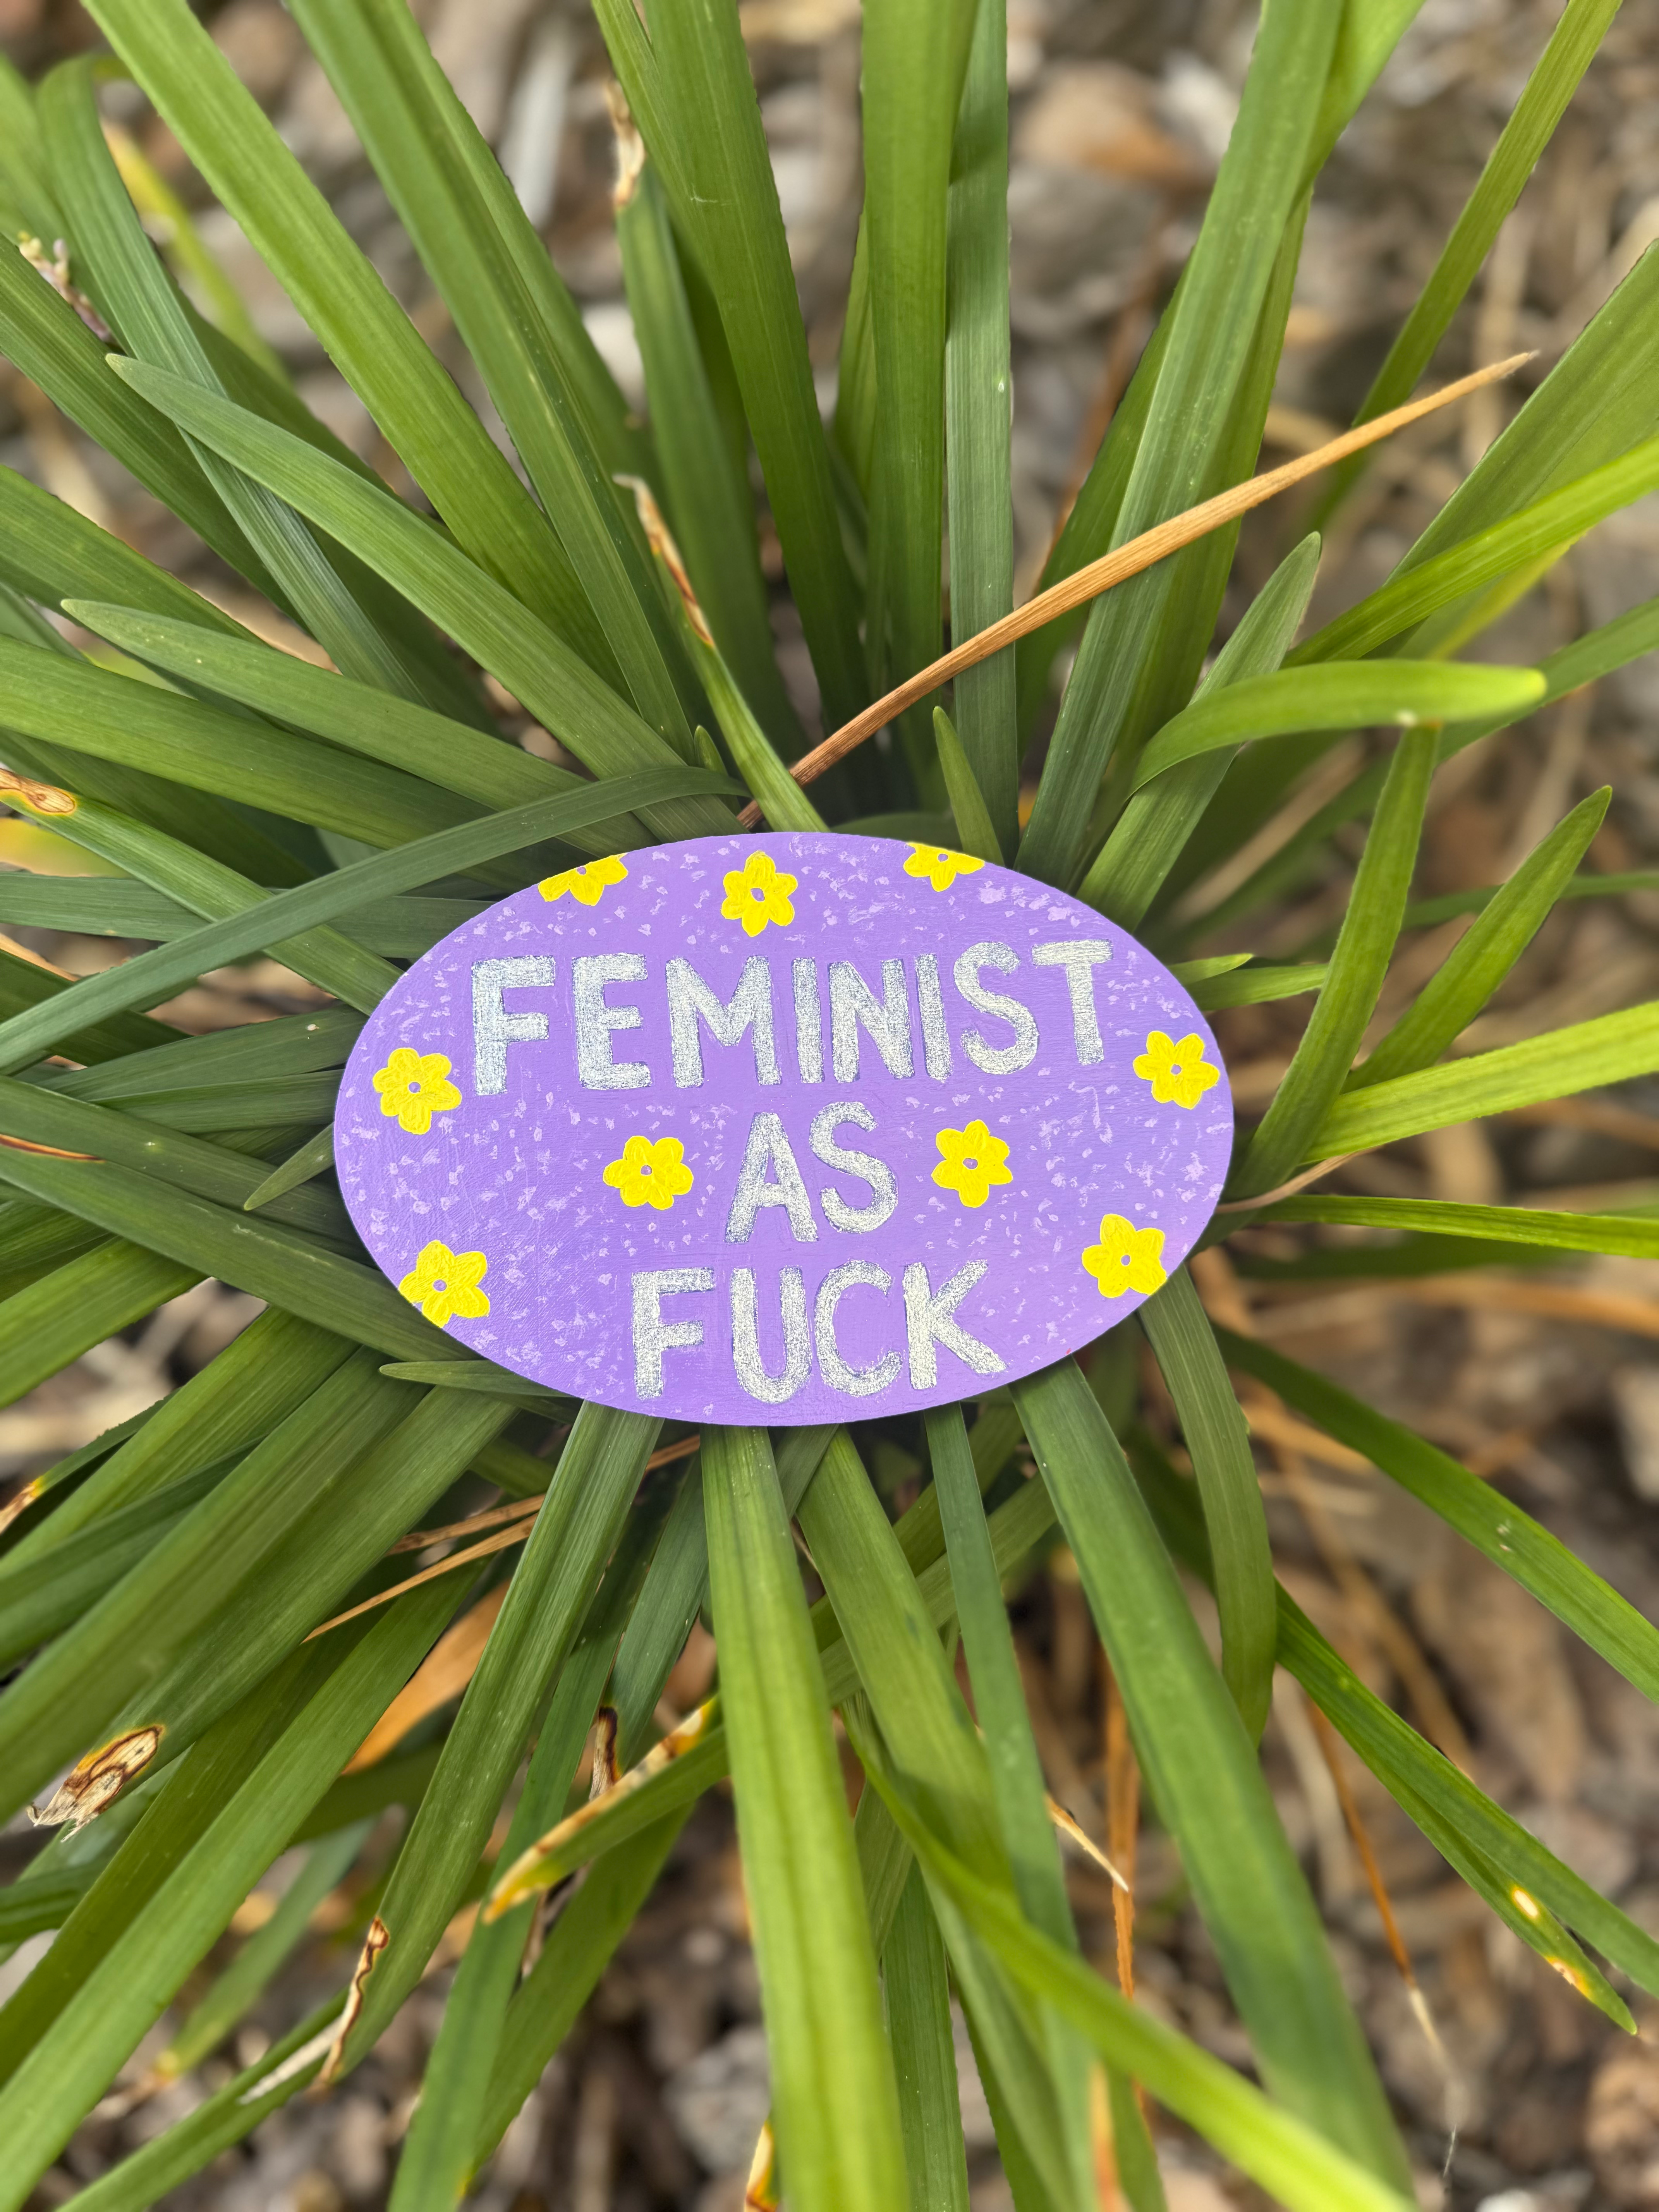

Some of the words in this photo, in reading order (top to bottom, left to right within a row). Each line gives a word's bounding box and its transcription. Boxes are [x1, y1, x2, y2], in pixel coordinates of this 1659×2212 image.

[471, 939, 1113, 1096] FEMINIST
[724, 1101, 898, 1243] AS
[631, 1258, 1009, 1404] FUCK
